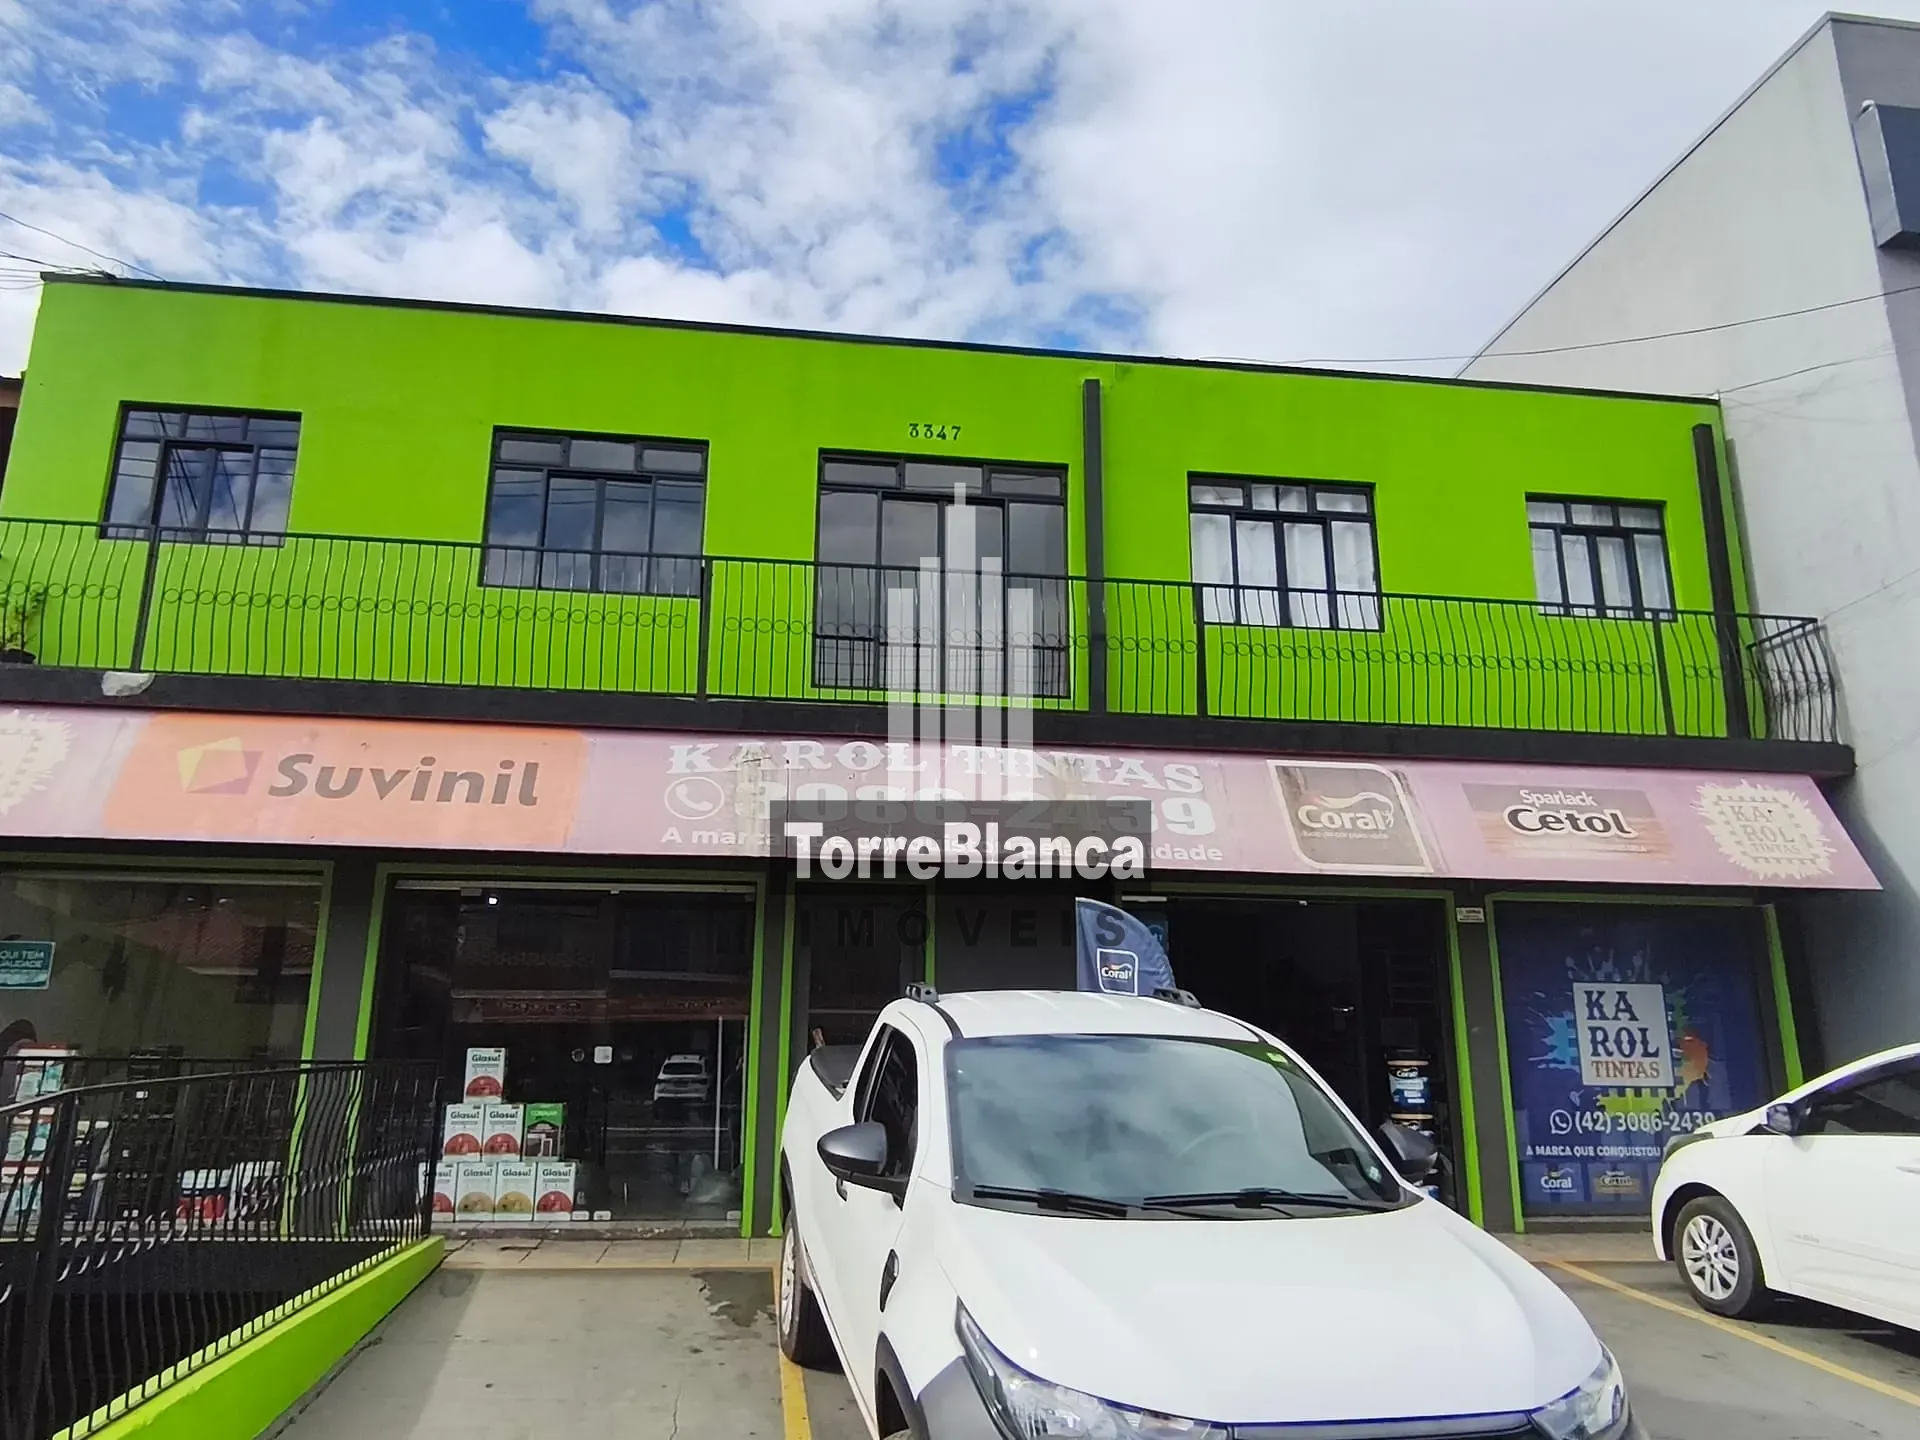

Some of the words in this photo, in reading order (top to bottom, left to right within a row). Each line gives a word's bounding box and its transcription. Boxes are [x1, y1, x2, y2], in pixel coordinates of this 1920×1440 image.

[909, 423, 961, 440] 3347
[666, 739, 926, 774] KAROL
[951, 745, 1204, 793] TINTAS
[267, 753, 539, 806] Suvinil
[1520, 790, 1598, 808] Sparlack
[1298, 804, 1386, 830] Coral
[1505, 806, 1637, 836] Cetol
[1730, 805, 1772, 822] KA
[660, 827, 683, 844] A
[1740, 824, 1795, 842] ROL
[1101, 967, 1128, 979] Coral
[1583, 990, 1639, 1022] KA
[1587, 1027, 1659, 1058] ROL
[1591, 1060, 1660, 1079] TINTAS
[1575, 1110, 1611, 1134] (42)
[1616, 1111, 1715, 1133] 3086-2439
[1526, 1147, 1534, 1156] A
[1535, 1146, 1572, 1157] MARCA
[1573, 1146, 1595, 1158] QUE
[1596, 1146, 1661, 1158] CONQUISTOU
[1540, 1176, 1572, 1189] Coral
